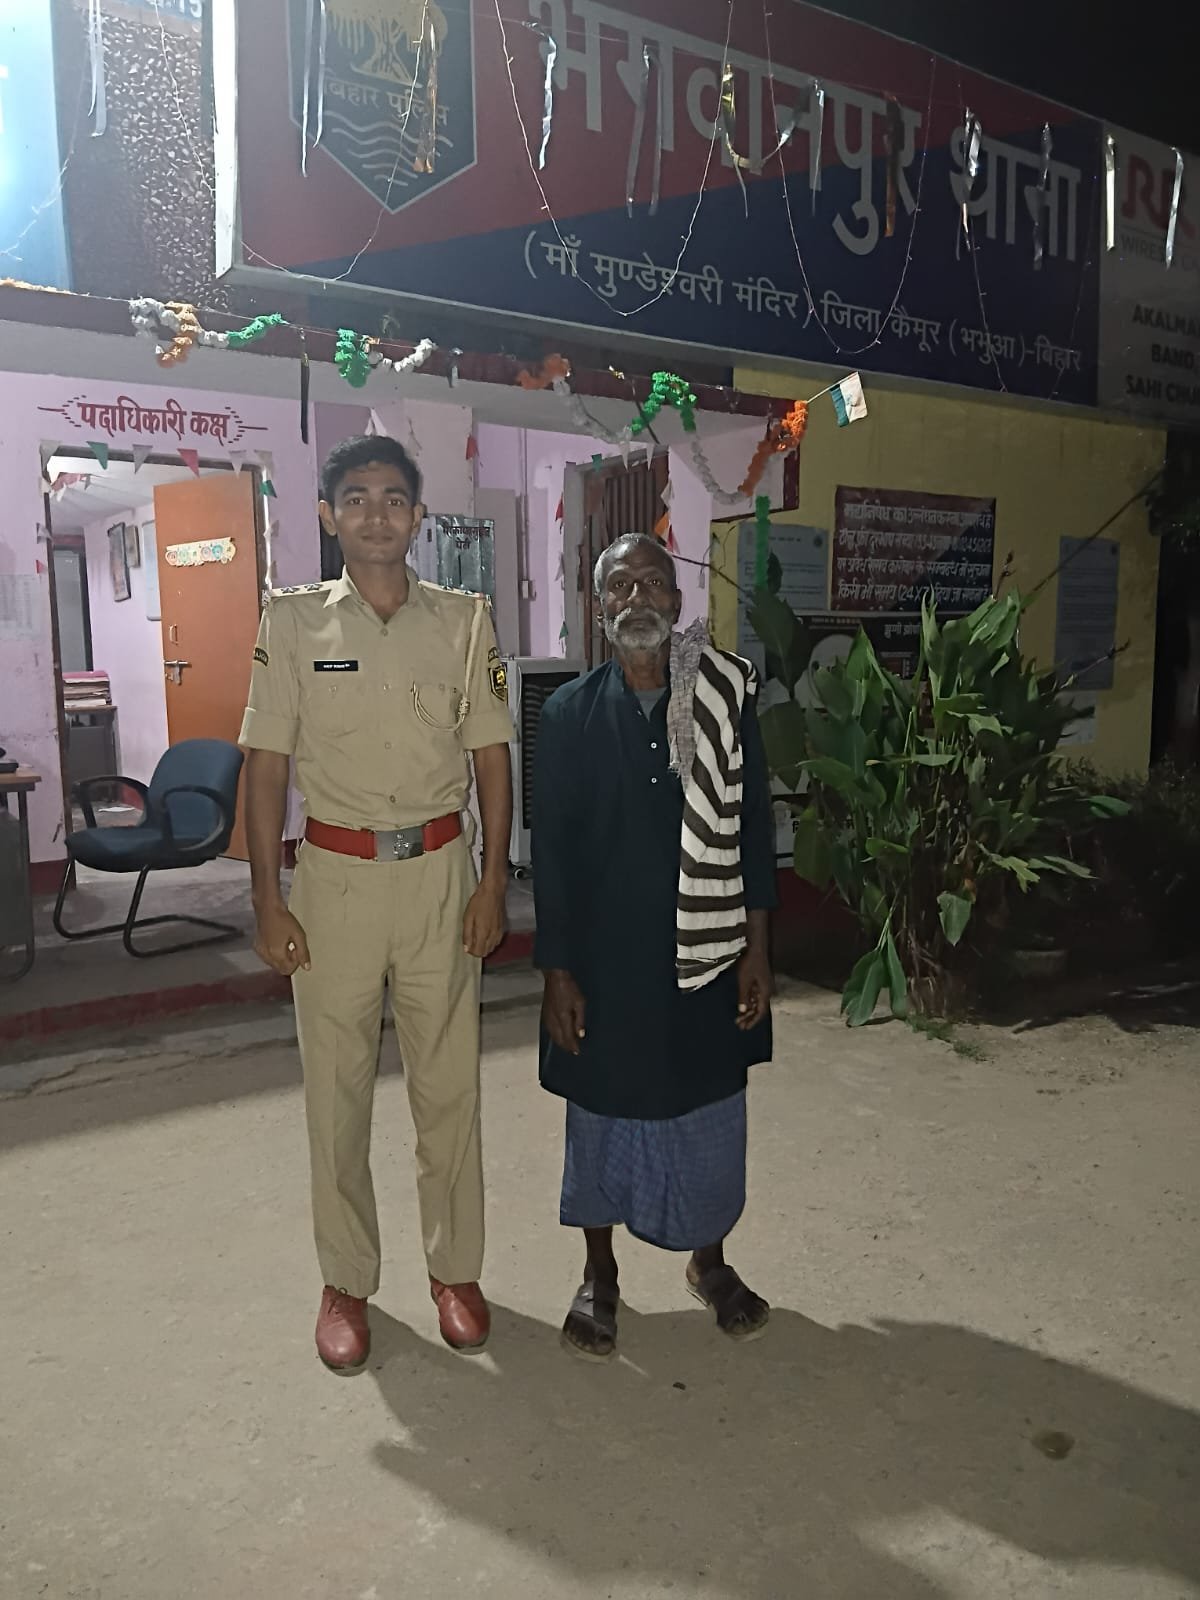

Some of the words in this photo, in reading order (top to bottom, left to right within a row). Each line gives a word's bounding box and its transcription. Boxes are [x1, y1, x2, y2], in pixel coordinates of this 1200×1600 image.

[529, 0, 922, 255] भगवानपुर
[950, 126, 1081, 263] थाना
[525, 231, 581, 279] (माँ
[590, 252, 723, 305] मुण्डेश्वरी
[732, 277, 814, 329] मंदिर)
[820, 289, 882, 332] जिला
[888, 304, 942, 352] कैमूर
[1132, 303, 1200, 337] AKALMA
[1126, 374, 1162, 400] SAHI
[78, 395, 187, 441] पदाधिकारी
[190, 411, 230, 446] कक्ष
